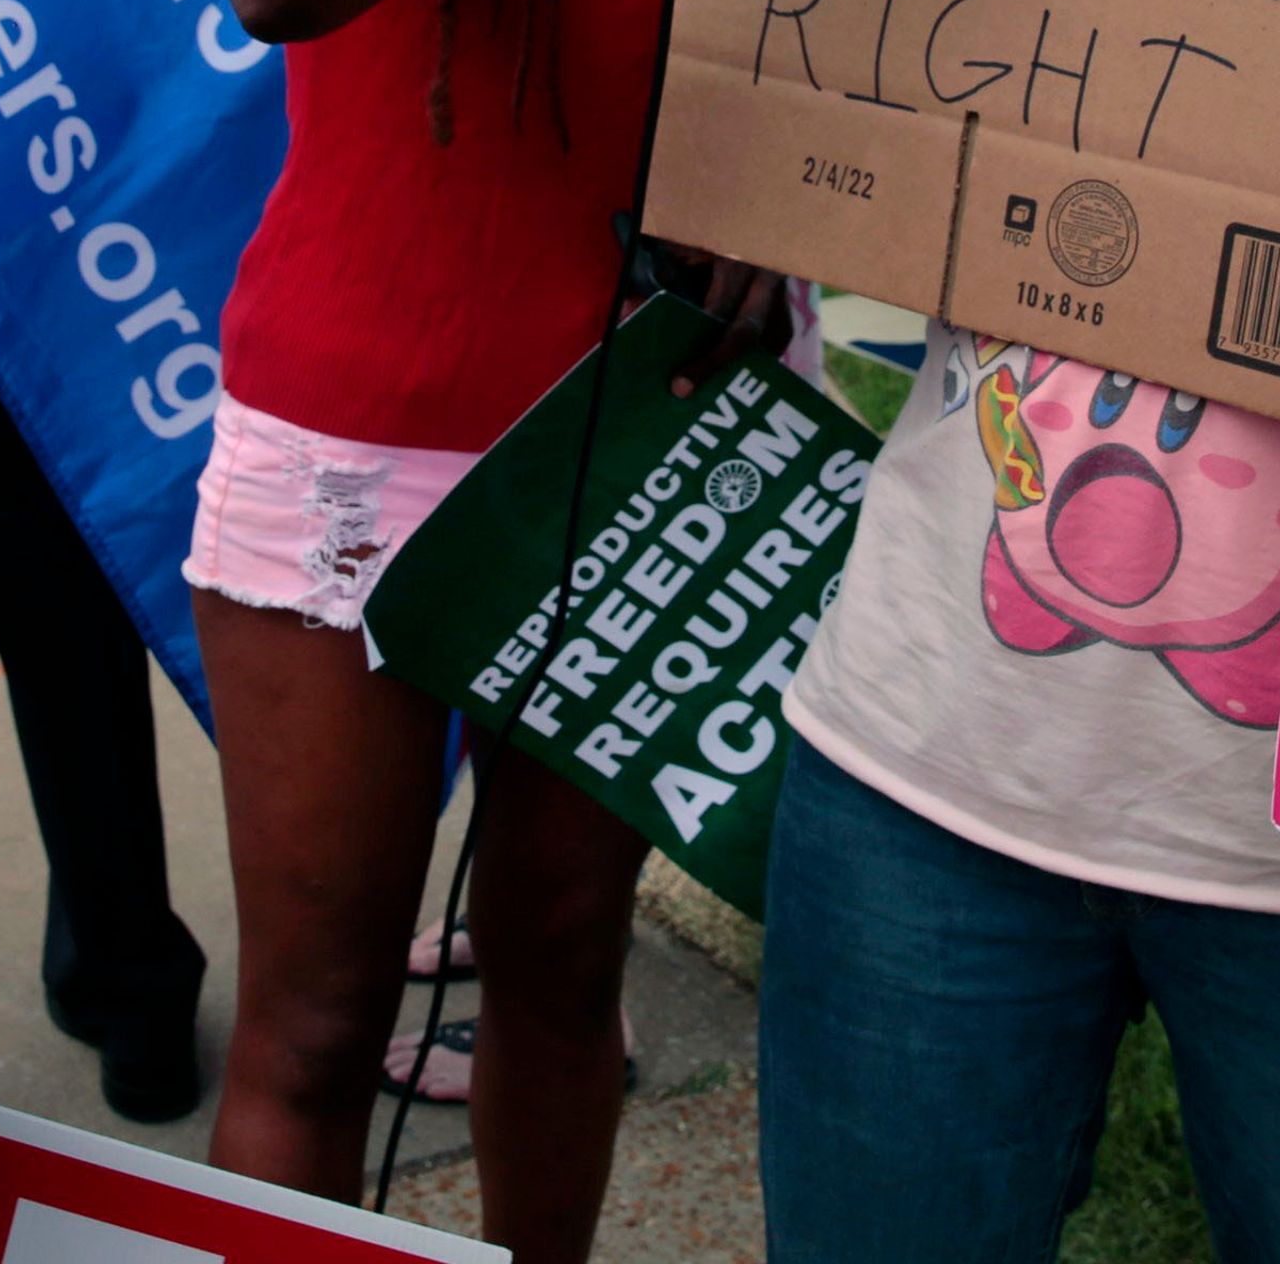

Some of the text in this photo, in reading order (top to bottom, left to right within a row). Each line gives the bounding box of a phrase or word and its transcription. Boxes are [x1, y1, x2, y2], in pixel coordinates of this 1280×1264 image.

[802, 156, 876, 201] 2/4/22
[1003, 229, 1032, 248] mpc
[469, 367, 770, 704] REPRODUCTIVE
[573, 449, 874, 780] REQUIRES
